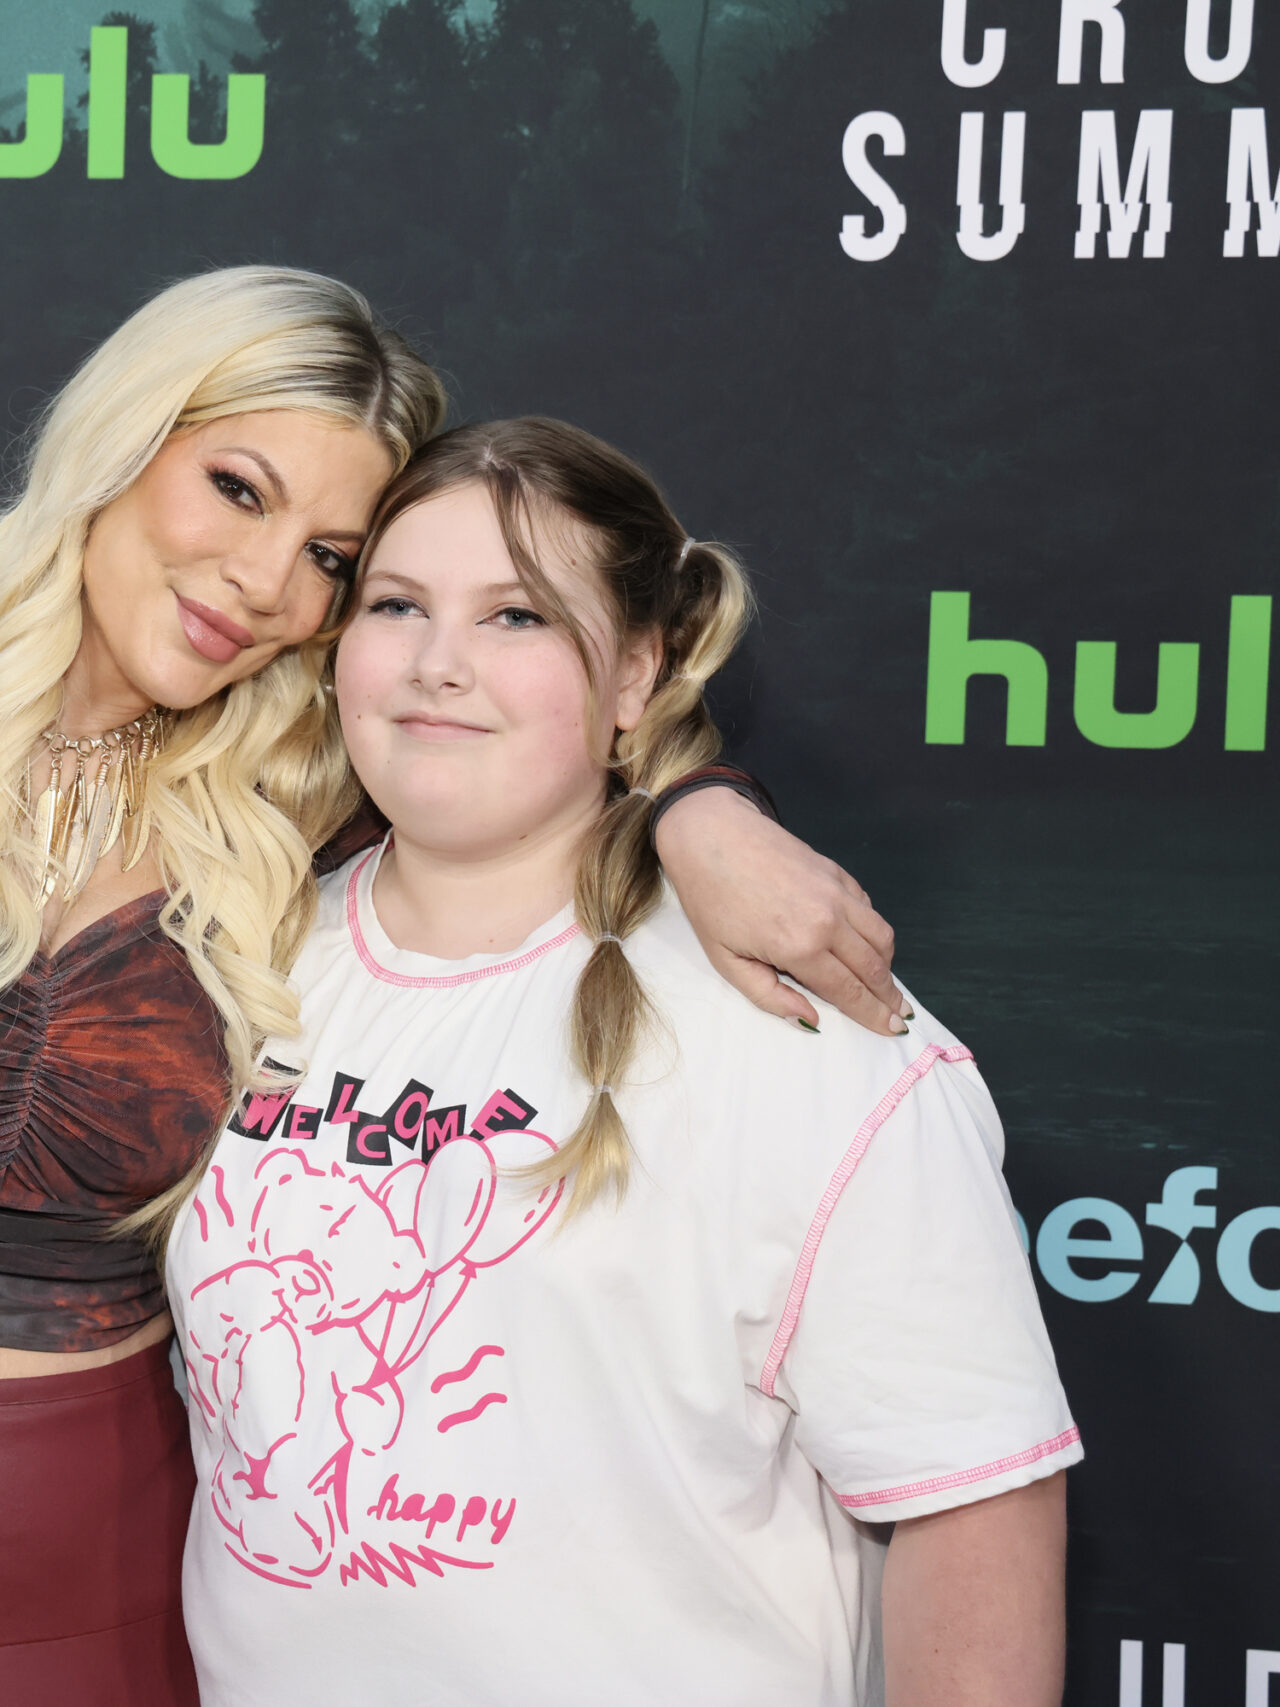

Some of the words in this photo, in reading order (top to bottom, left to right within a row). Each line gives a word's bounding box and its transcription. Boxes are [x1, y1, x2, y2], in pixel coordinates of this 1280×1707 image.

[925, 591, 1272, 751] hul
[1014, 1165, 1280, 1313] efo
[366, 1473, 517, 1545] happy
